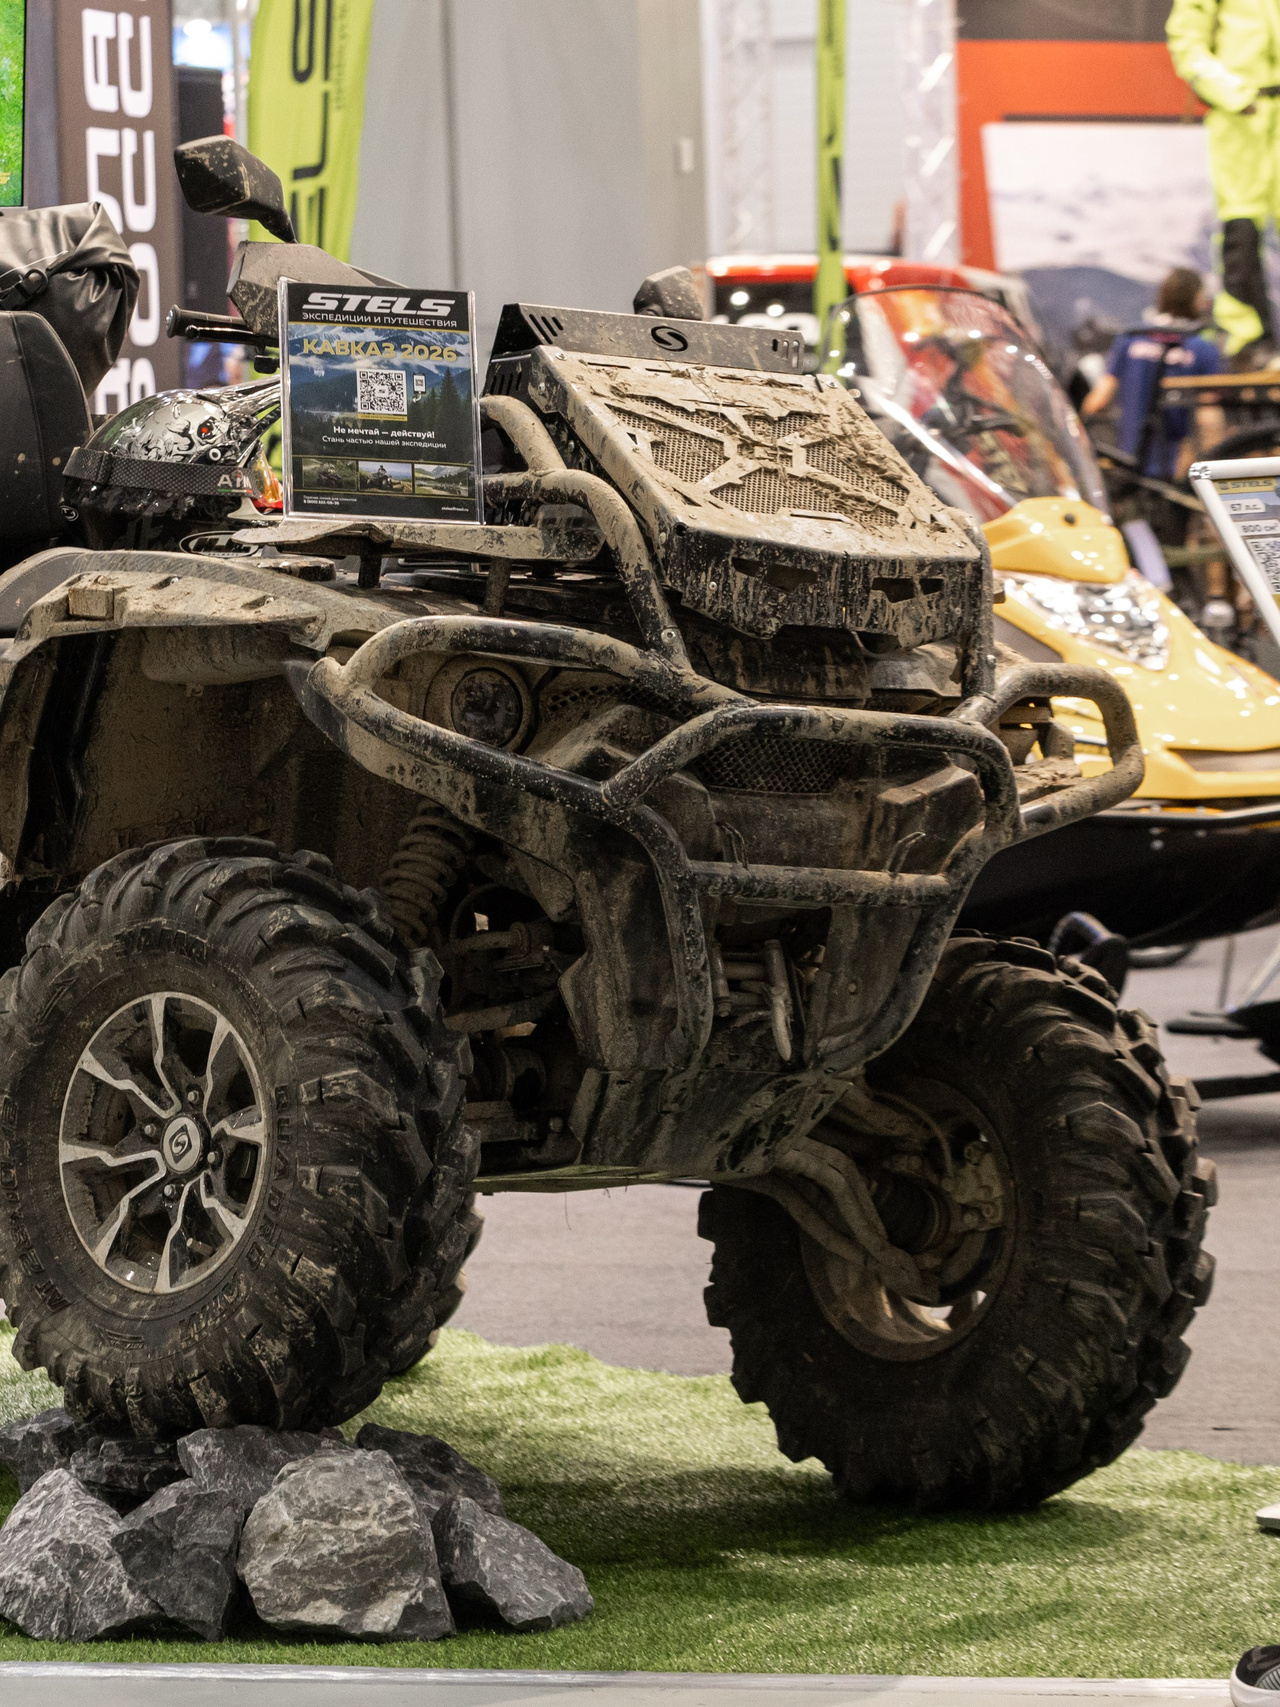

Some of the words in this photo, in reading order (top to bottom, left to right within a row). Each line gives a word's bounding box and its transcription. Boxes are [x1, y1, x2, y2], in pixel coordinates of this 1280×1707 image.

[302, 292, 456, 317] STELS
[302, 312, 371, 323] ЭКСПЕДИЦИИ
[384, 316, 458, 328] ПУТЕШЕСТВИЯ
[303, 338, 396, 359] КАВКАЗ
[400, 343, 458, 362] 2026
[333, 425, 346, 434] Не
[348, 428, 380, 436] мечтай
[390, 429, 435, 439] действуй!
[322, 435, 345, 443] Стань
[401, 441, 447, 449] экспедиции
[1231, 480, 1273, 489] STELS
